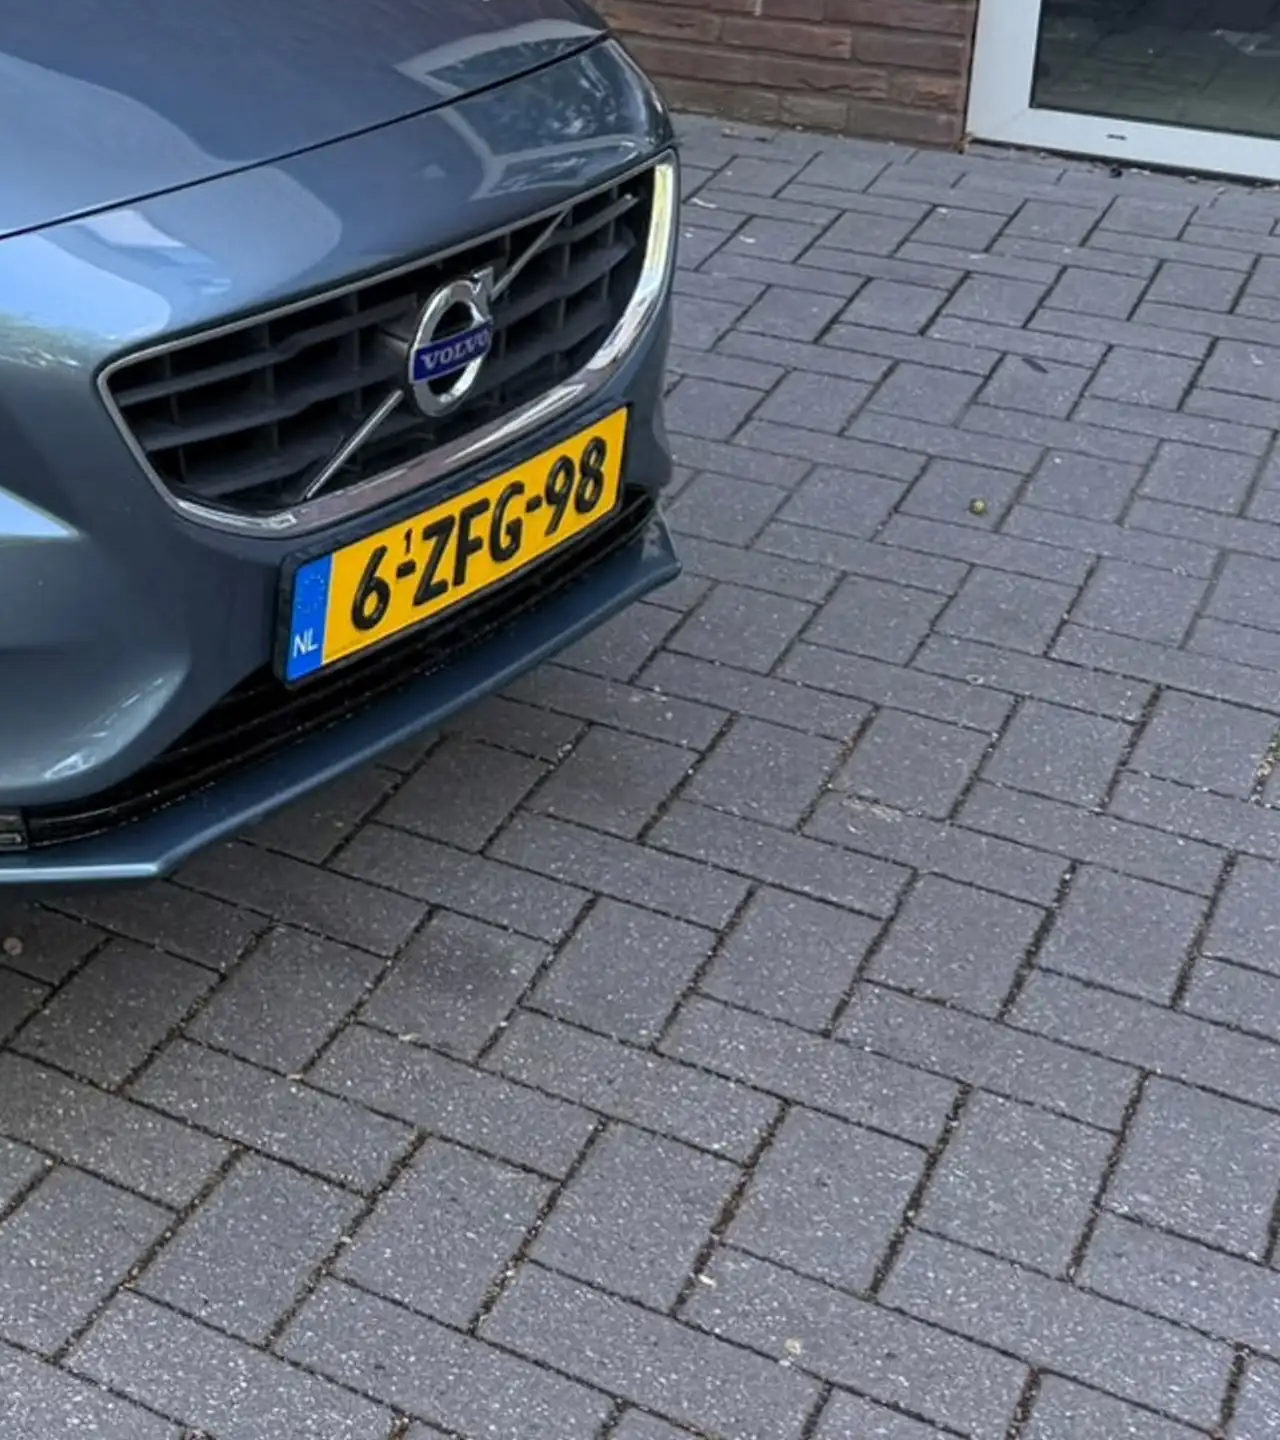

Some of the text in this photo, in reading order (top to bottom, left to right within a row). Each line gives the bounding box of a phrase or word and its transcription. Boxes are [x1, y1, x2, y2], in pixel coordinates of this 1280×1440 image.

[420, 327, 490, 371] VOLVO
[351, 436, 608, 633] 6-ZFG-98
[292, 627, 319, 659] NL
